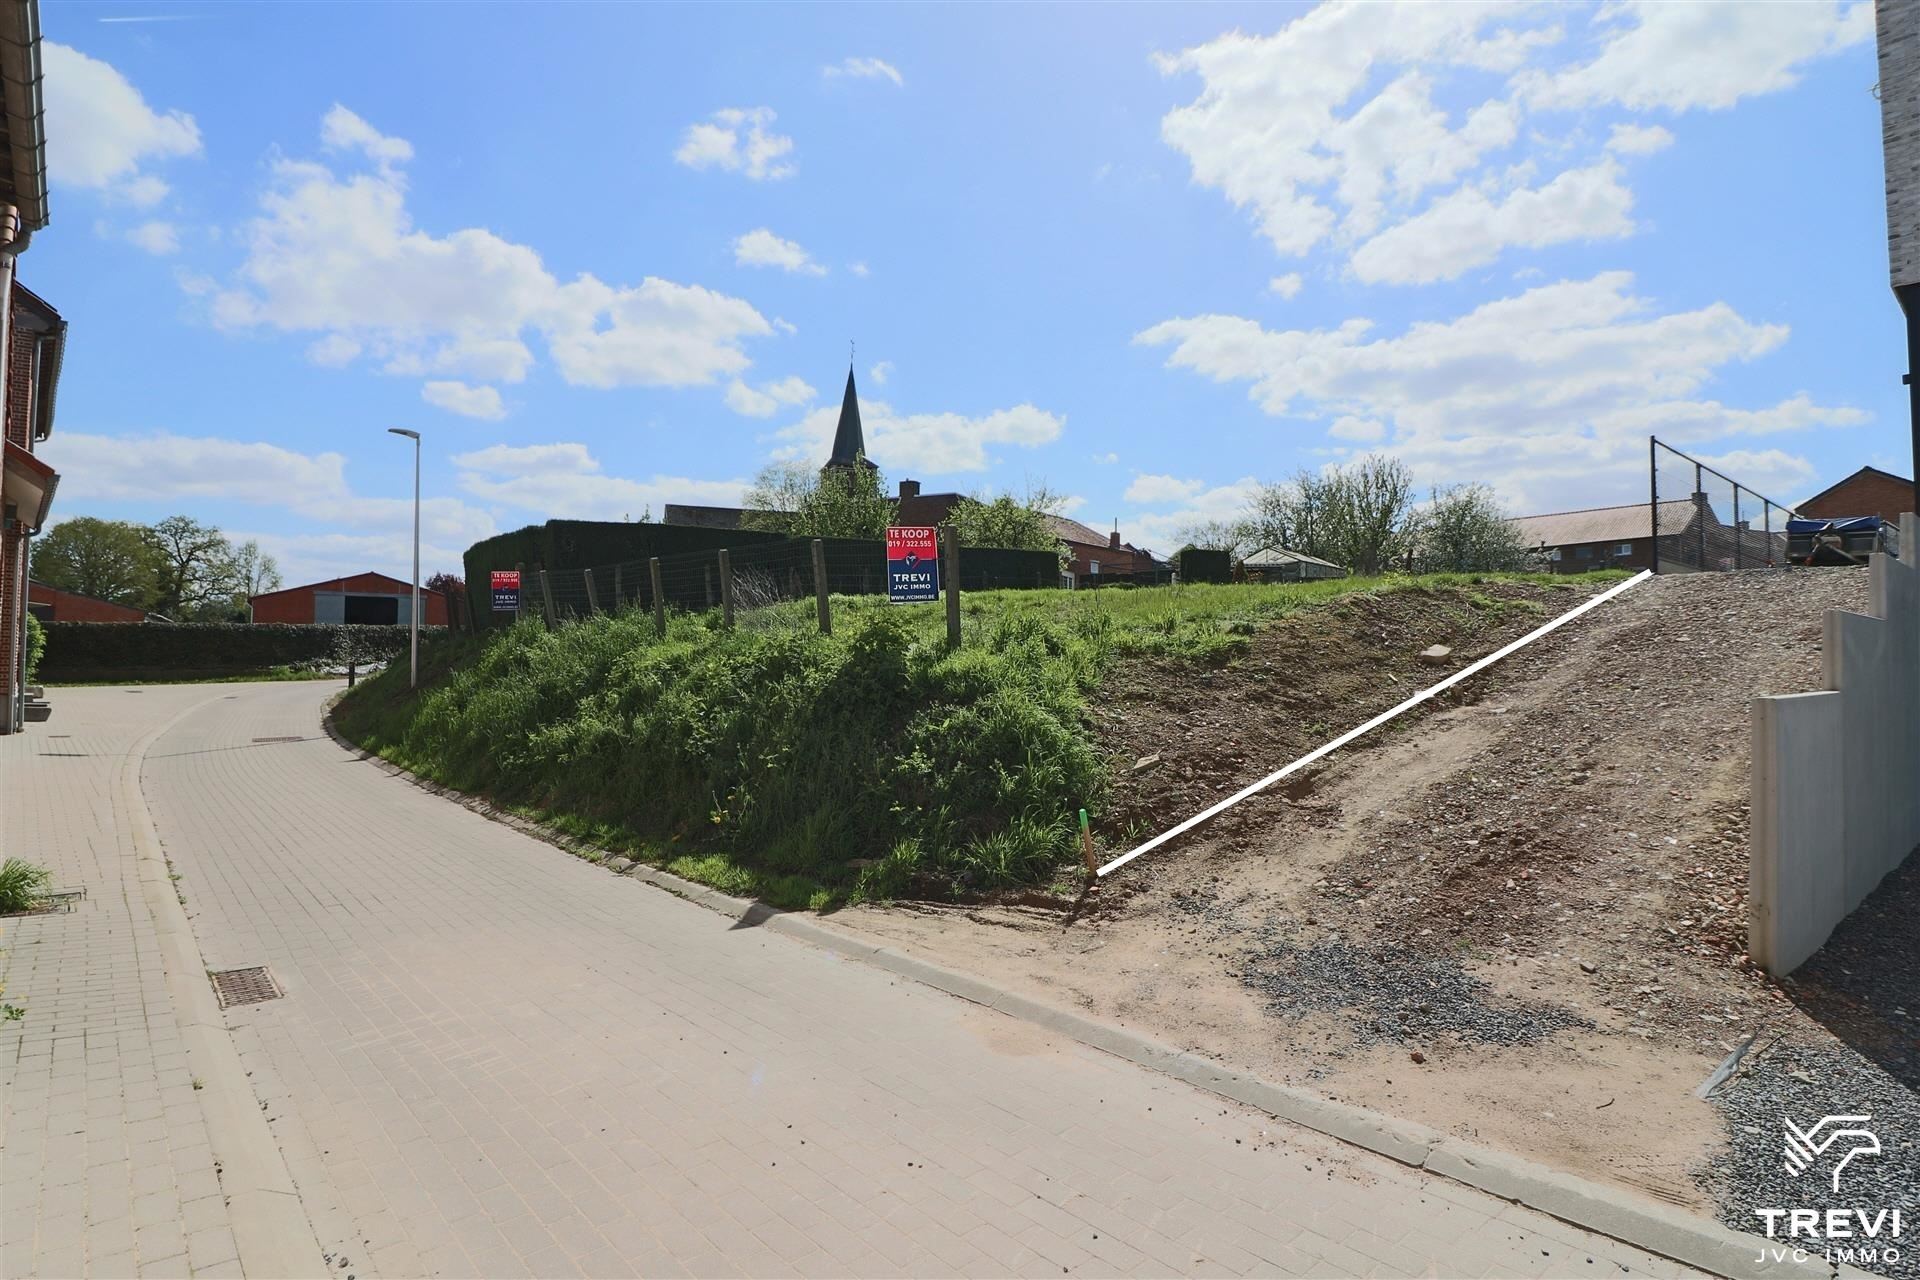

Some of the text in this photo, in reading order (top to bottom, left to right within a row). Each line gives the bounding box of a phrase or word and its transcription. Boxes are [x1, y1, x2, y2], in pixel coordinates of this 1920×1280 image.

[889, 530, 929, 538] TE KOOP
[893, 573, 930, 582] TREVI
